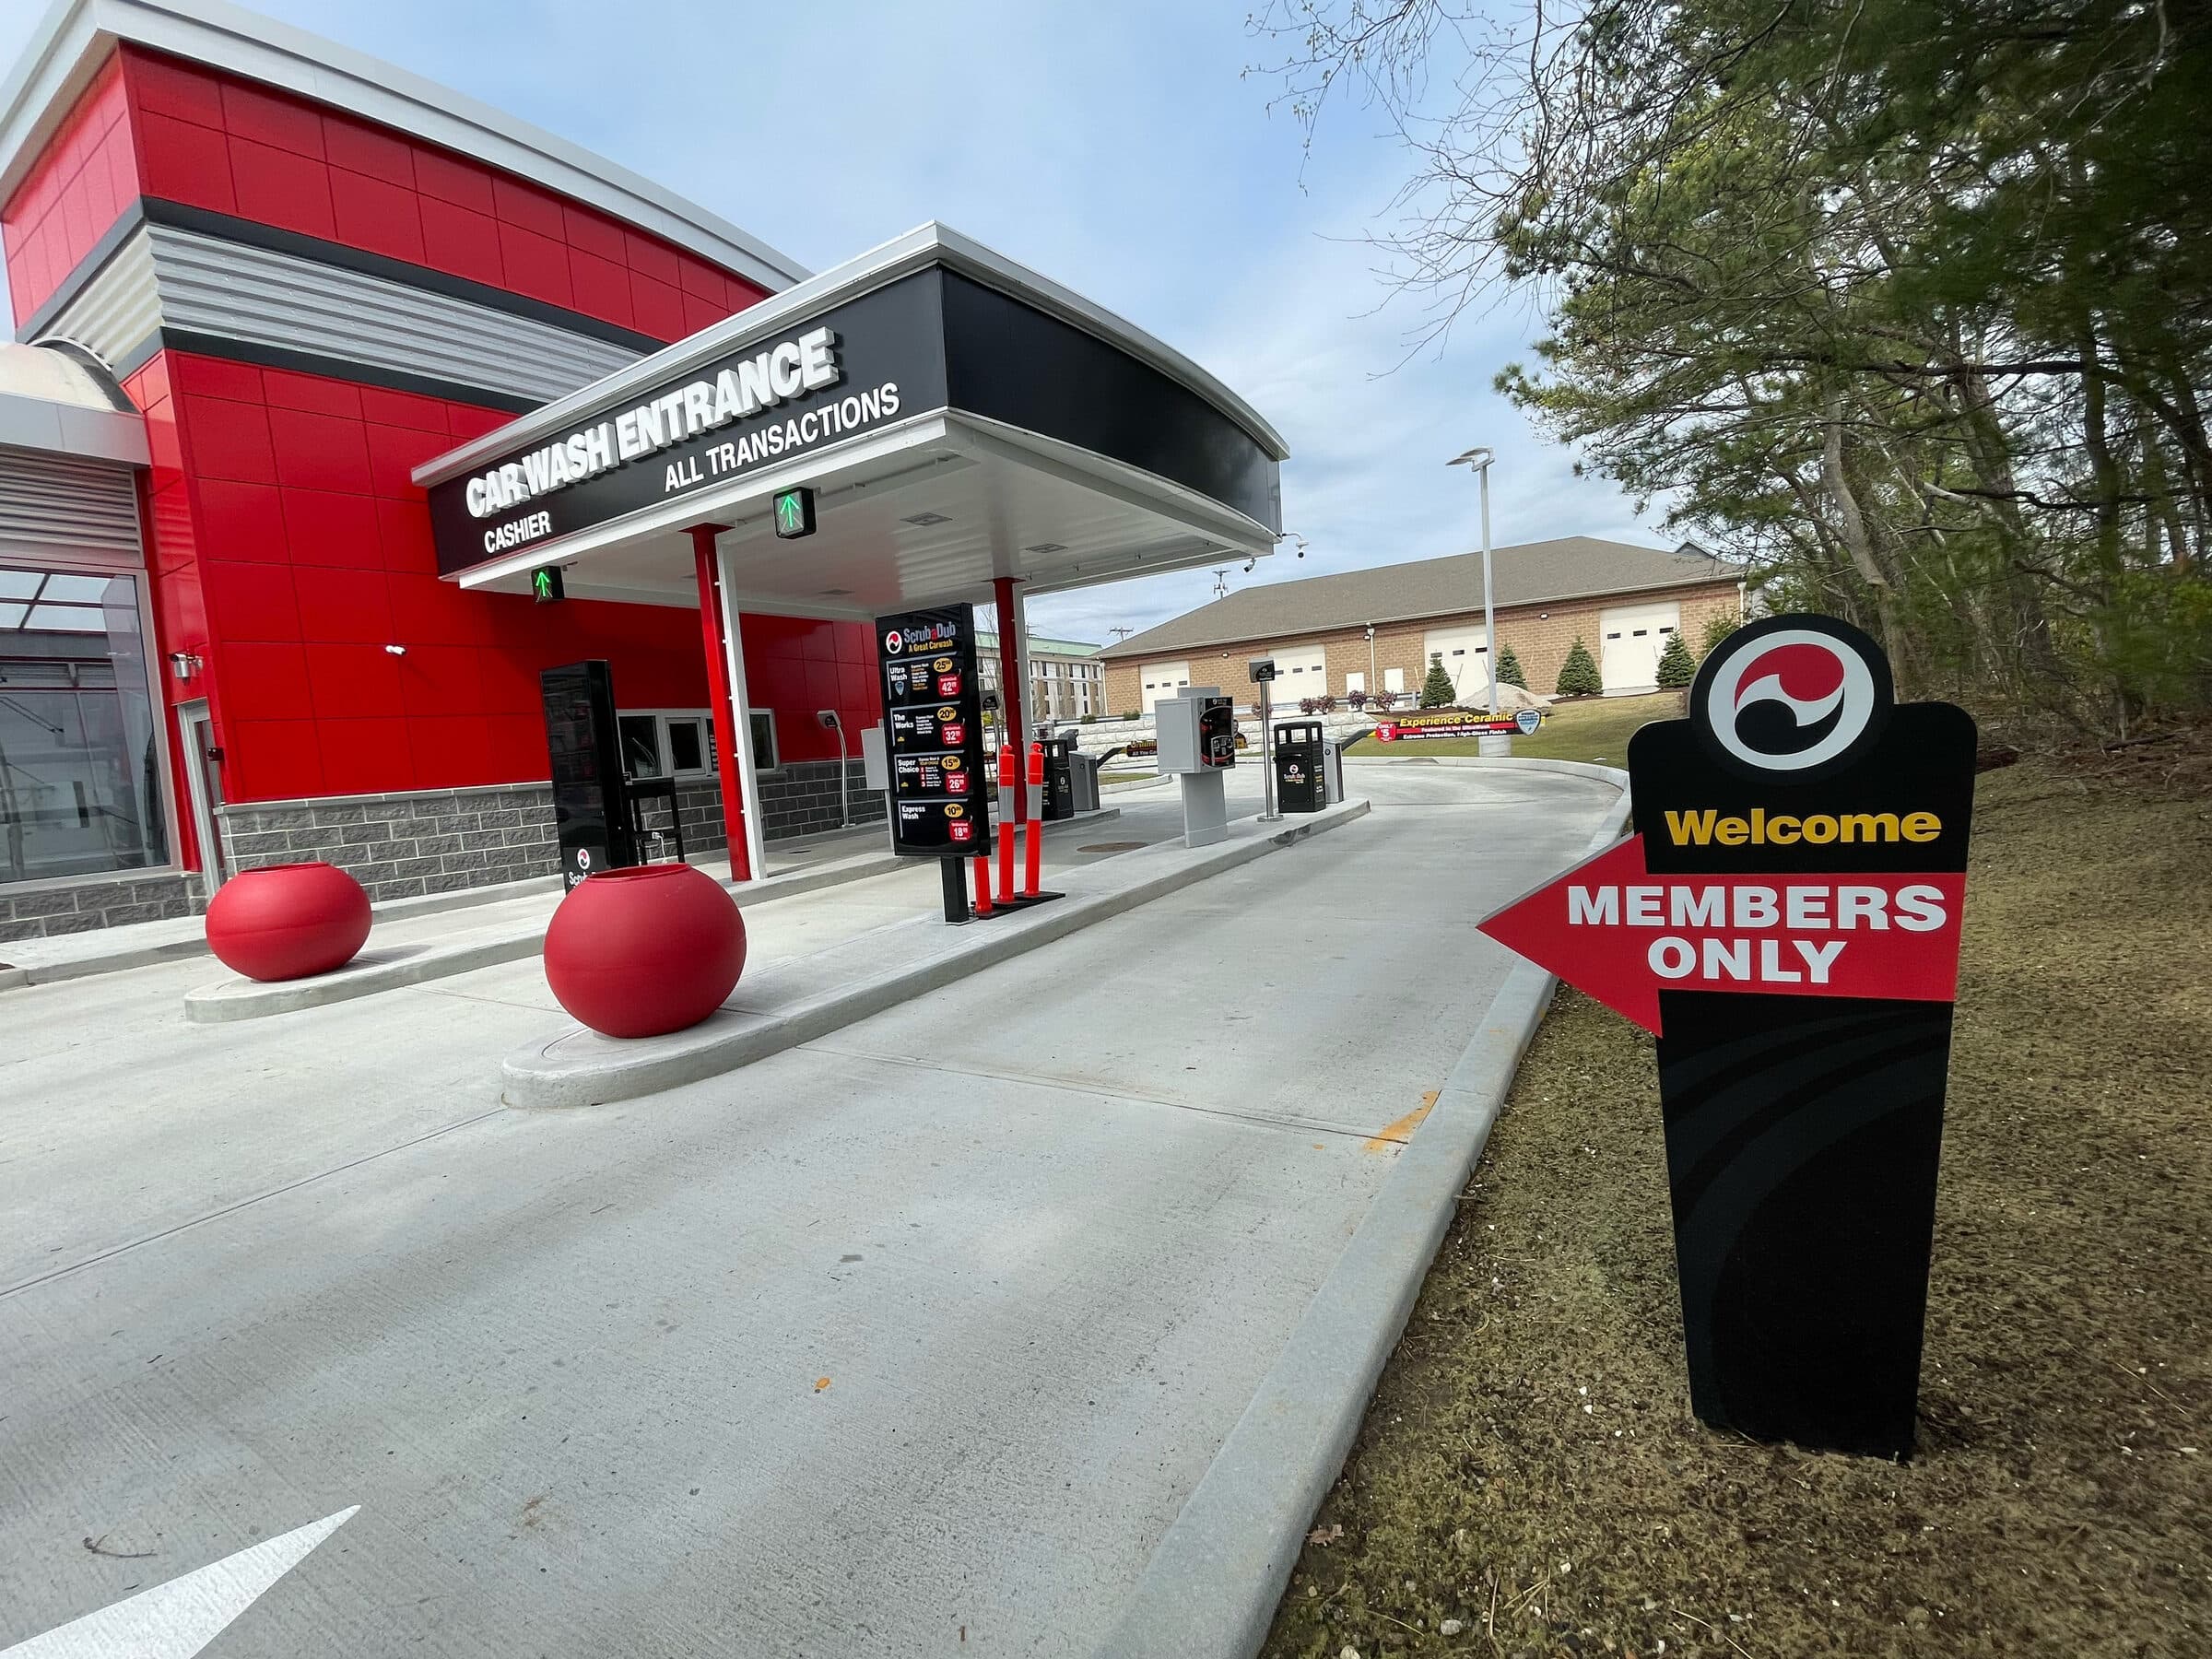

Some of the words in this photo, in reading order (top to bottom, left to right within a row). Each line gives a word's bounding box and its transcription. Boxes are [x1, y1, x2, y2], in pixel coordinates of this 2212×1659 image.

[466, 463, 530, 518] CAR
[522, 422, 619, 496] WASH
[616, 326, 840, 461] ENTRANCE
[665, 456, 704, 492] ALL
[705, 382, 900, 475] TRANSACTIONS
[484, 511, 552, 553] CASHIER
[913, 642, 928, 652] Great
[889, 666, 905, 675] Ultra
[890, 674, 907, 682] Wash
[1400, 716, 1461, 727] Experience
[1465, 712, 1512, 724] Ceramic
[898, 759, 916, 768] Super
[1665, 807, 1942, 845] Welcome
[1568, 885, 1947, 932] MEMBERS
[1647, 936, 1848, 983] ONLY
